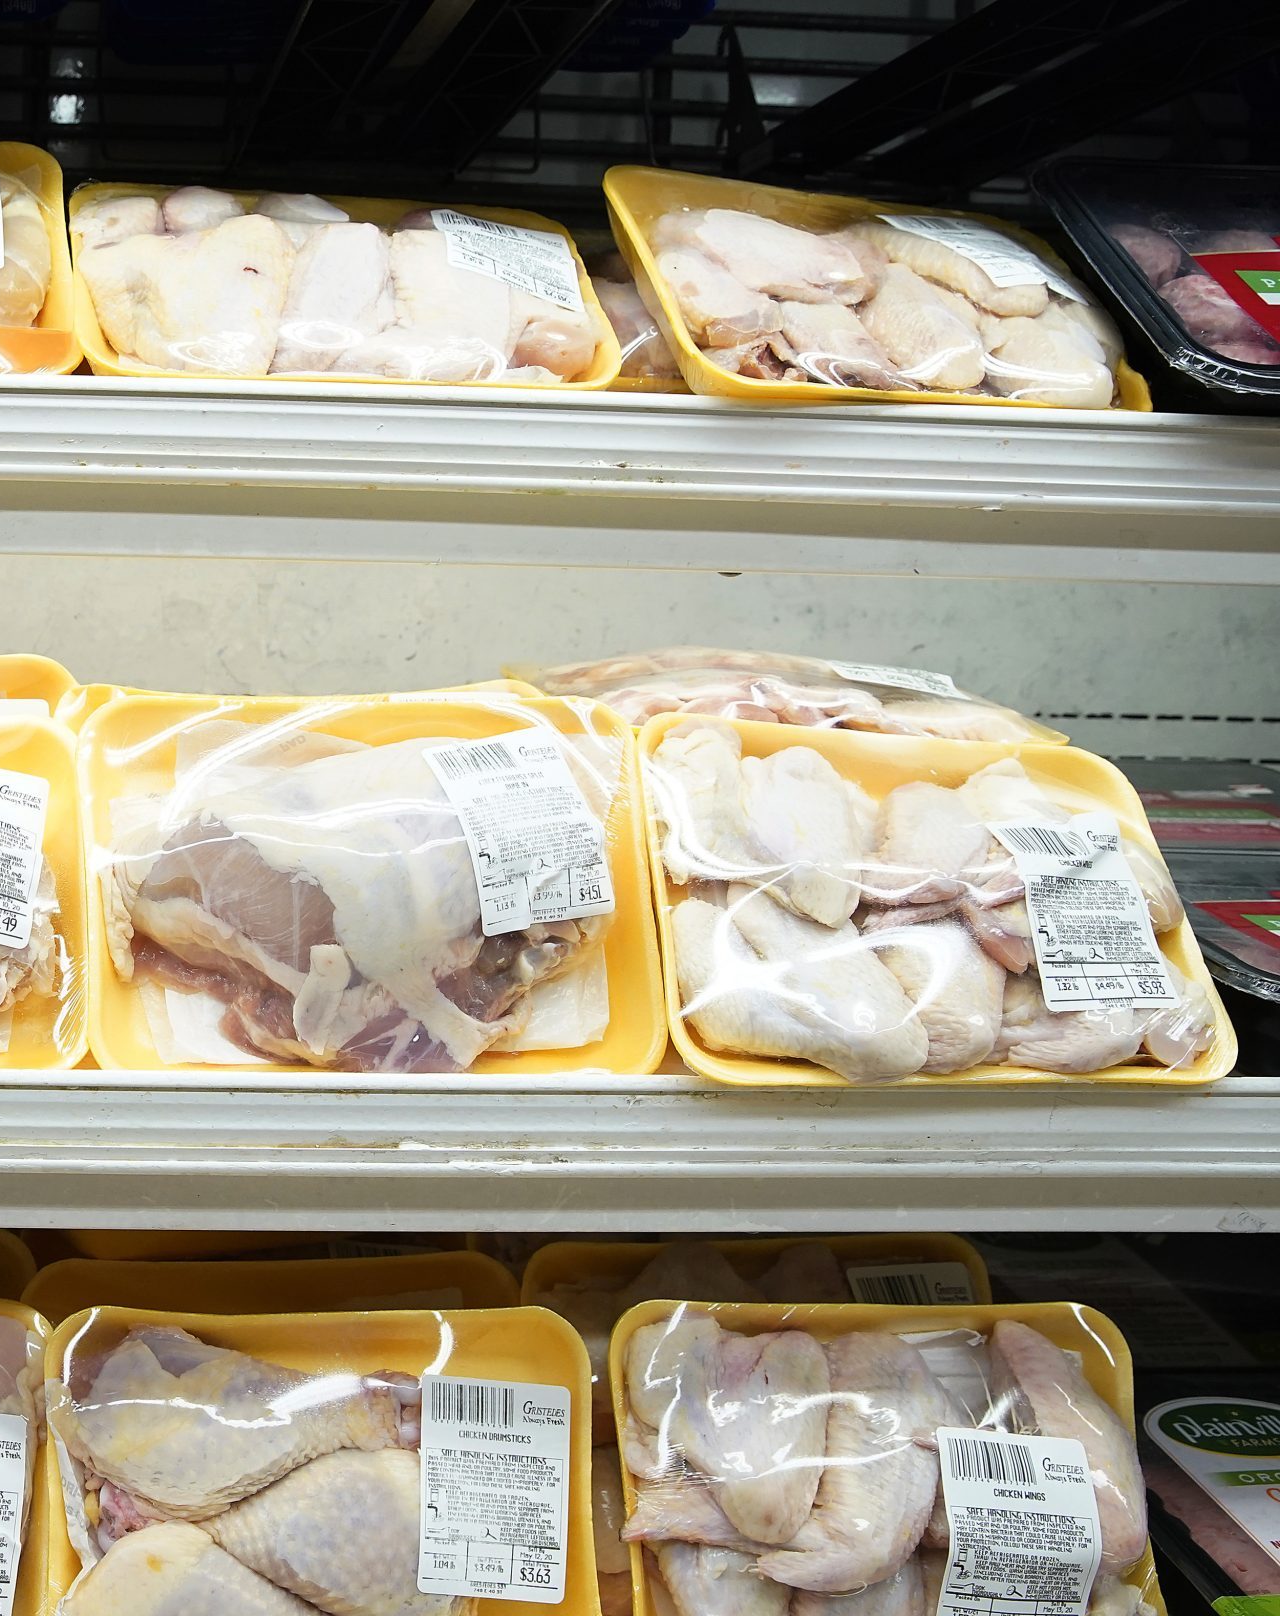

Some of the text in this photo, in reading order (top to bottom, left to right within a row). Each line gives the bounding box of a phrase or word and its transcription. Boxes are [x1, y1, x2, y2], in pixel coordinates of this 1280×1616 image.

[0, 784, 41, 804] GRISTEDES
[579, 885, 602, 901] $4.51
[1058, 983, 1071, 991] 1.32
[1140, 982, 1166, 995] $5.93
[523, 1401, 566, 1417] GRISTEDES
[523, 1416, 565, 1426] Always Fresh
[459, 1430, 532, 1444] CHICKEN DRUMSTICKS
[5, 1451, 21, 1459] Fresh
[441, 1449, 546, 1465] SAFE HANDLING INSTRUCTIONS
[1042, 1458, 1084, 1475] GRISTEDES
[1045, 1474, 1086, 1484] Always Fresh
[994, 1488, 1046, 1501] CHICKEN WINGS
[966, 1508, 1076, 1524] SAFE HANDLING INSTRUCTIONS
[520, 1551, 535, 1560] May
[536, 1553, 545, 1561] 12,
[433, 1560, 448, 1570] 1.04
[474, 1563, 503, 1573] $3.49/lb
[520, 1567, 551, 1584] $3.63
